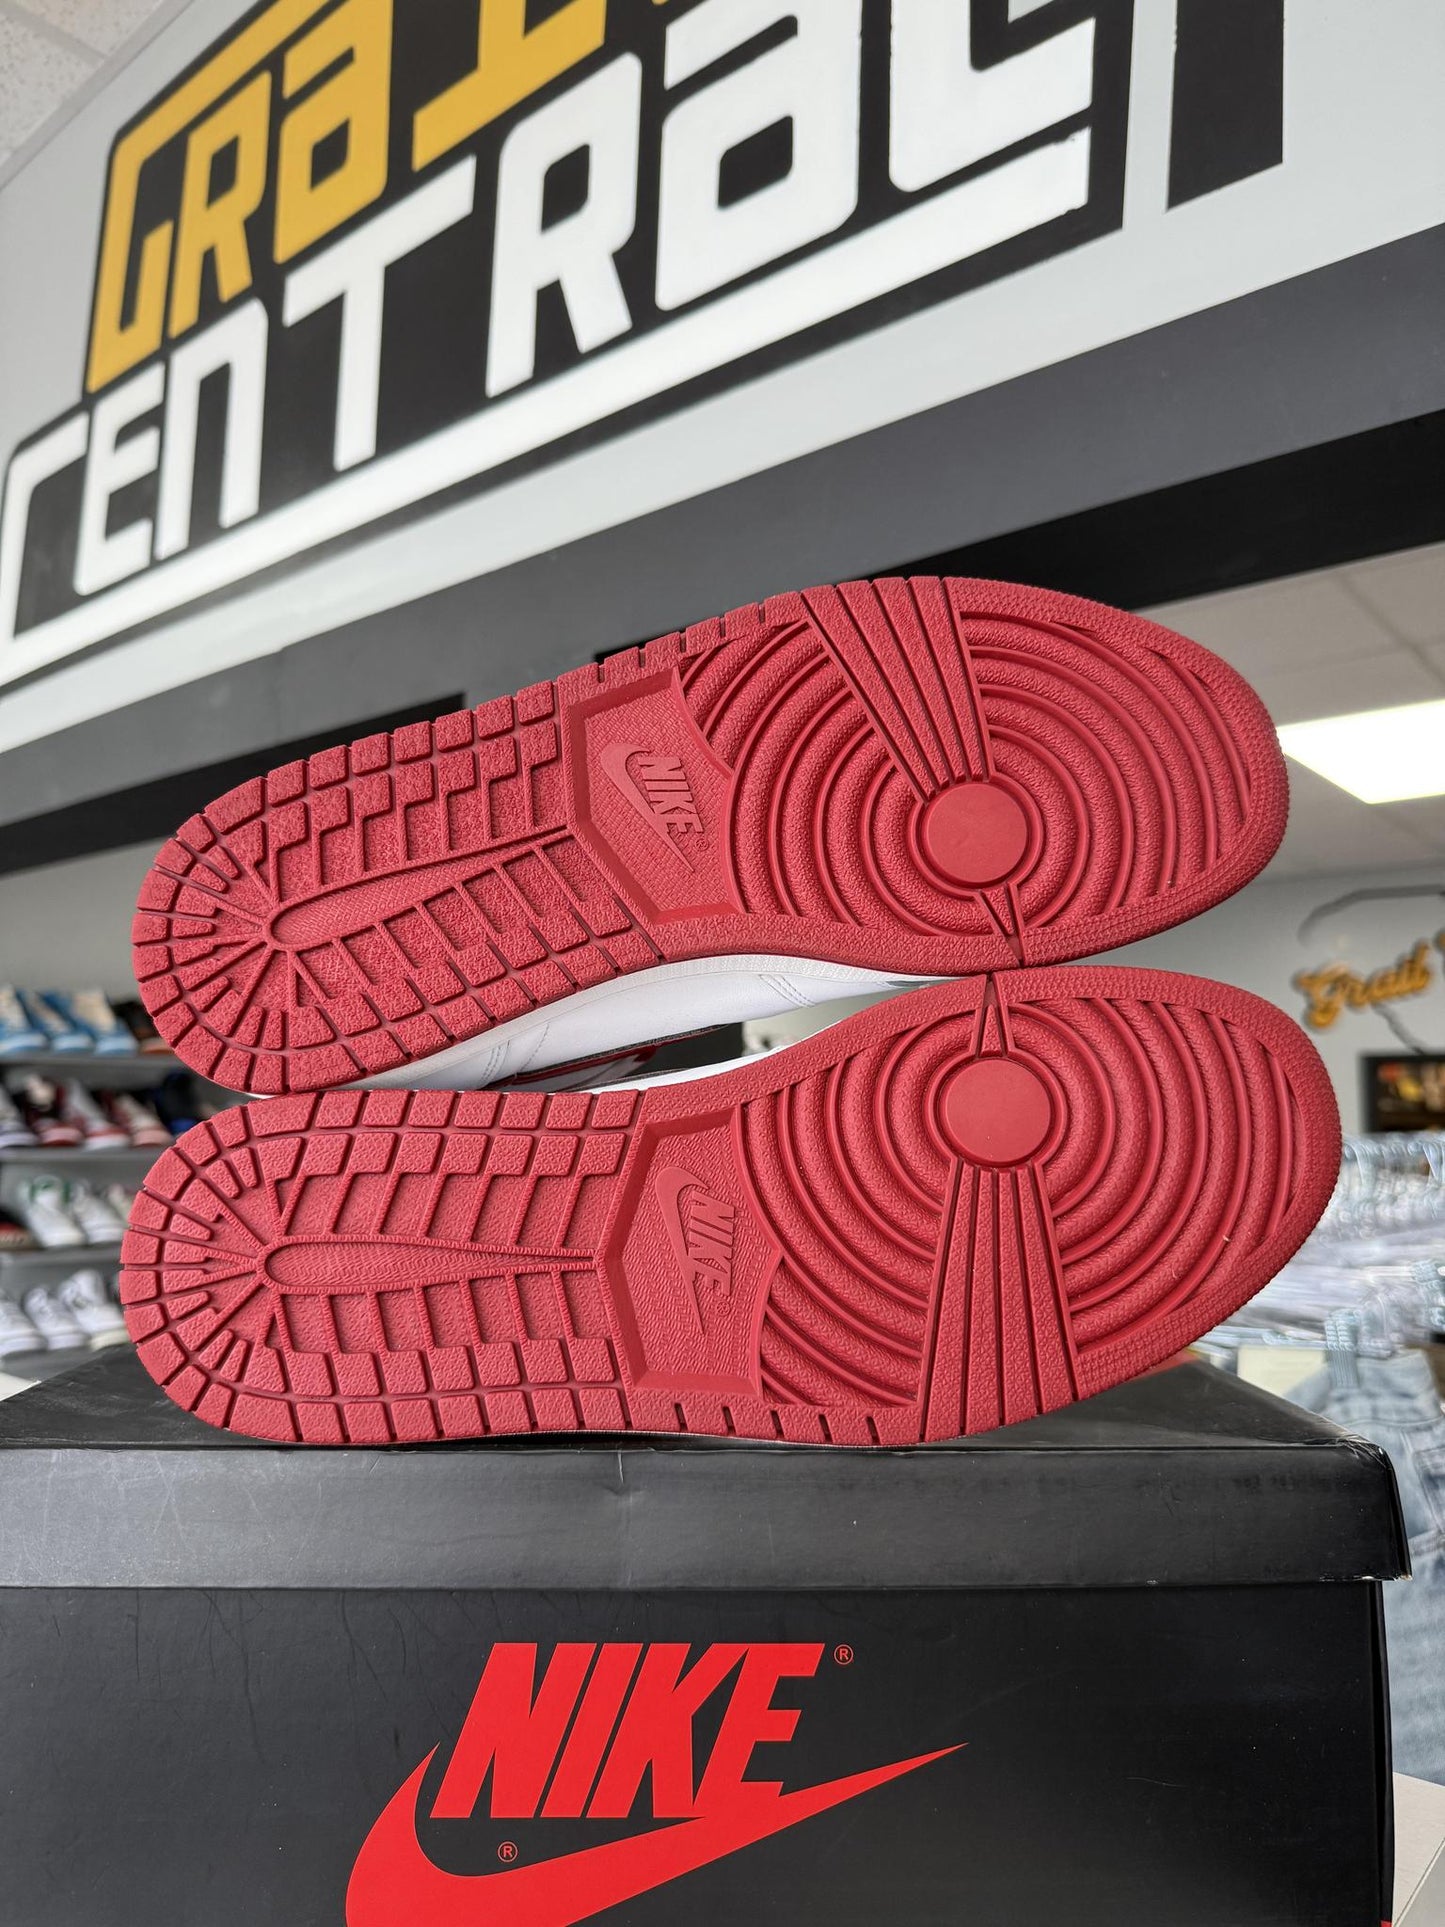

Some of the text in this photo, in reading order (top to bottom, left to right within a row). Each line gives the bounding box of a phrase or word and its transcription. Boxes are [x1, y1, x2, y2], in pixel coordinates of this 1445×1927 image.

[637, 755, 705, 834] NIKE
[690, 1190, 735, 1296] NIKE
[429, 1642, 825, 1818] NIKE
